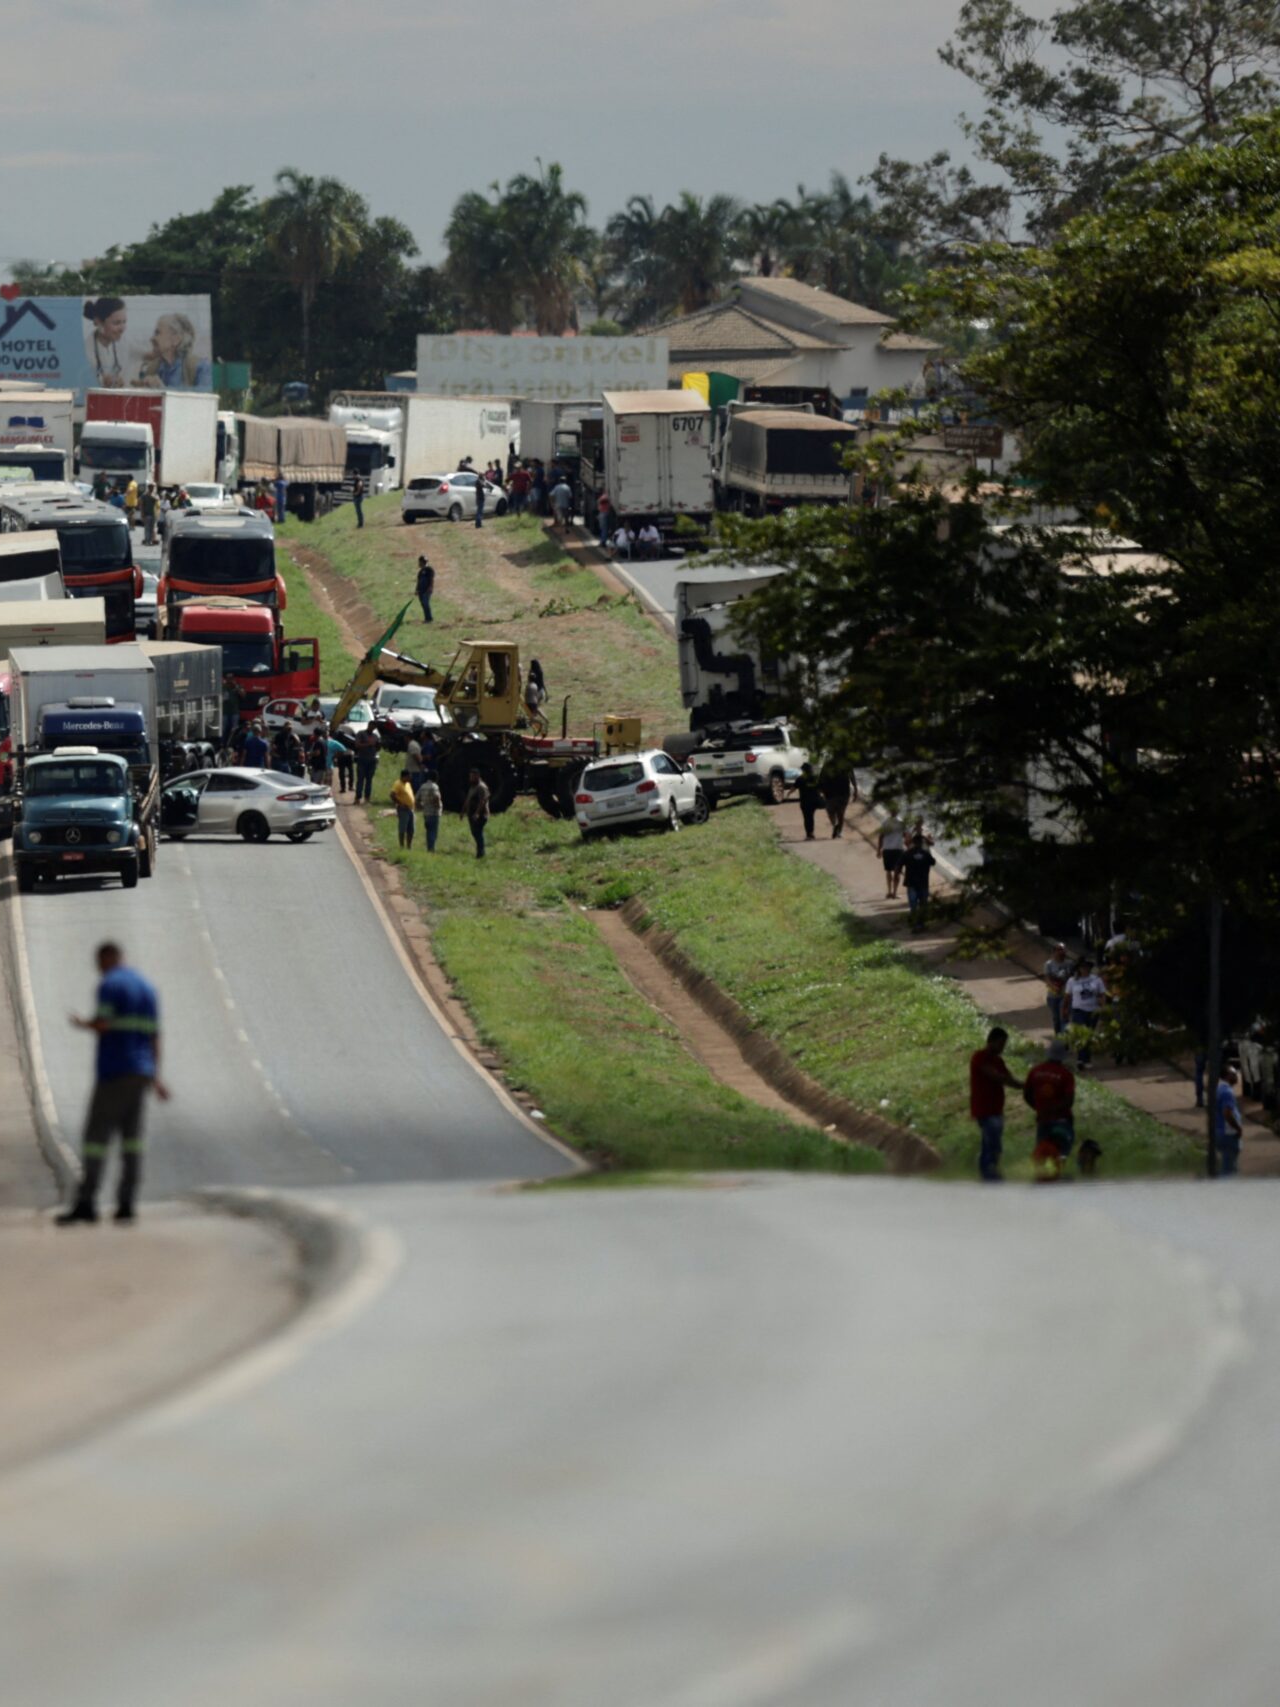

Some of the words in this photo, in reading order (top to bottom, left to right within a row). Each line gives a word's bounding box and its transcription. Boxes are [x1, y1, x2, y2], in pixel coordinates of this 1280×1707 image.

[1, 339, 56, 353] HOTEL
[12, 353, 60, 370] VOVÔ
[672, 415, 705, 432] 6707
[62, 720, 125, 731] Mercedes-Benz
